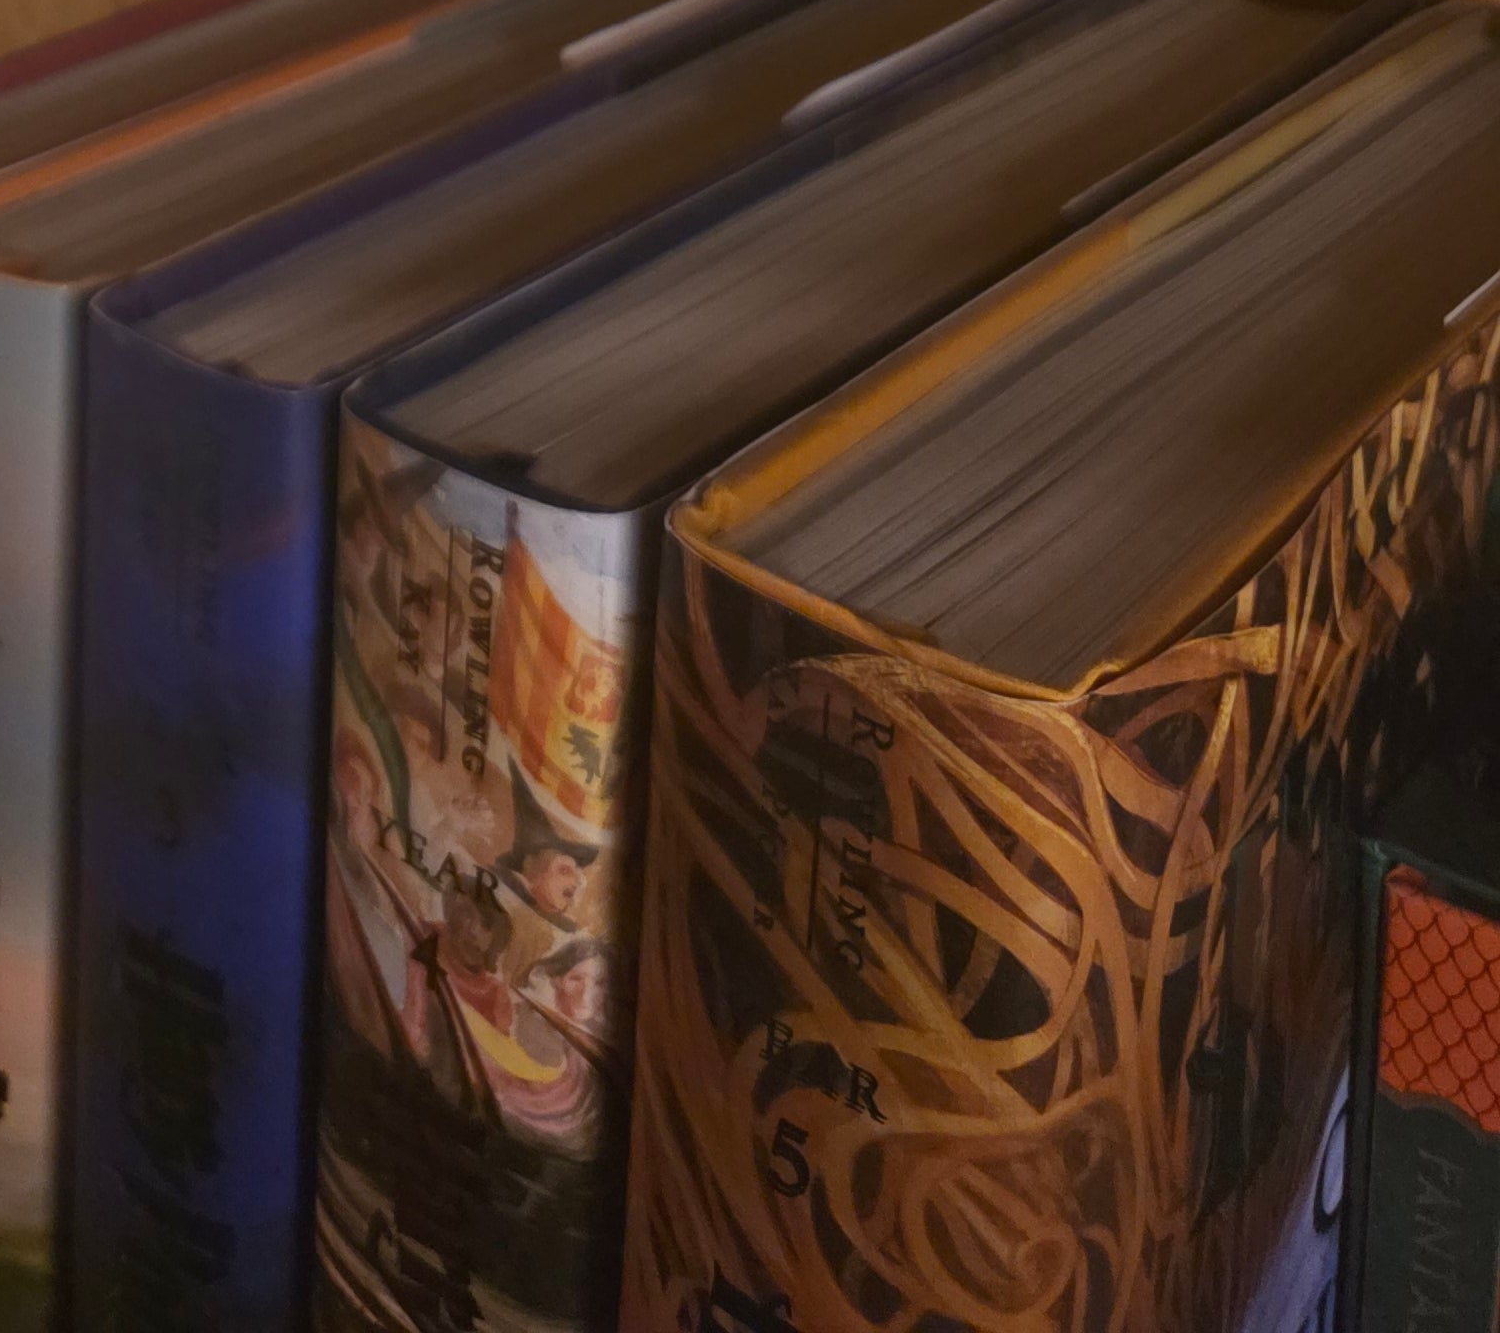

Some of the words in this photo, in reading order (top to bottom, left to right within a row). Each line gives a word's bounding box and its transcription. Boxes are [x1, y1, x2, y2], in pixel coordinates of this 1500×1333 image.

[463, 540, 504, 778] ROWLING
[370, 805, 504, 912] YEAR
[768, 1117, 810, 1199] 5
[1408, 1146, 1463, 1333] FANTA
